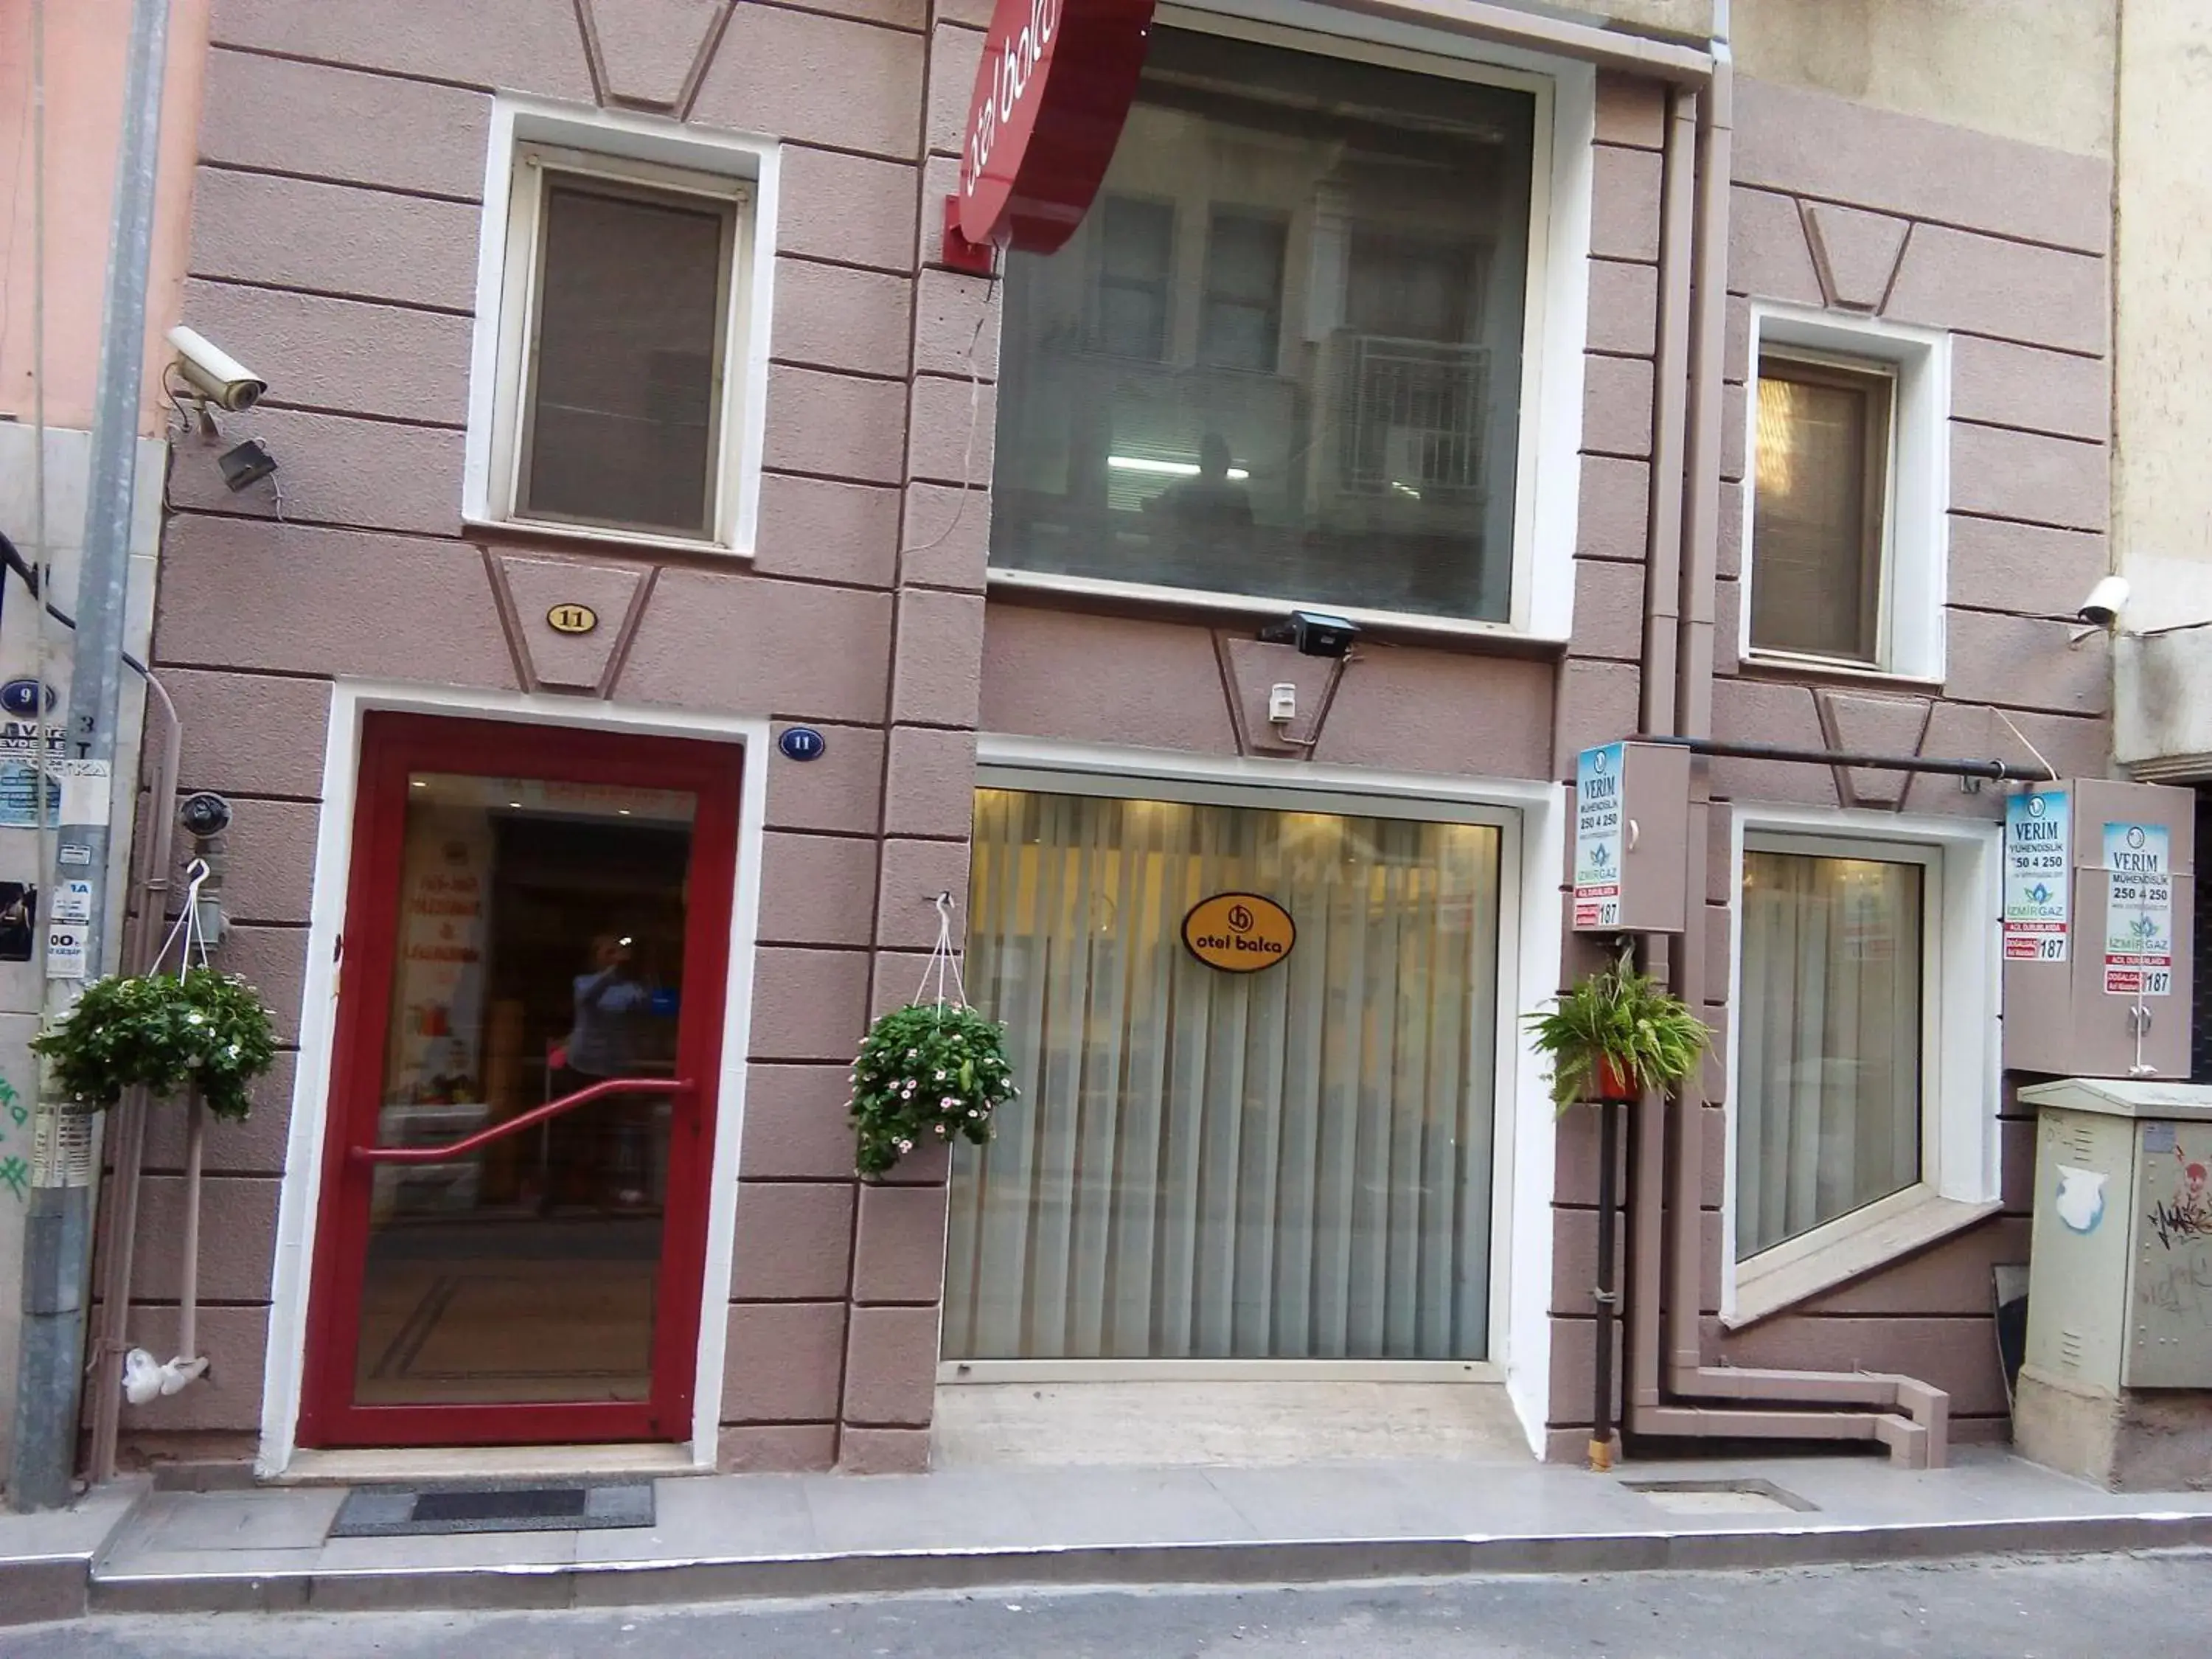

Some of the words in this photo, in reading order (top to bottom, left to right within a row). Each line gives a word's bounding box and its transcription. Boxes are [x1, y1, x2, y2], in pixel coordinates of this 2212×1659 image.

[559, 610, 584, 627] 11
[20, 688, 32, 703] 9
[79, 715, 95, 733] 3
[76, 741, 92, 759] T
[795, 736, 810, 750] 11
[1584, 772, 1615, 799] VERİM
[1580, 816, 1594, 830] 250
[1596, 815, 1601, 827] 4
[1602, 813, 1617, 826] 250
[2014, 816, 2059, 841] VERİM
[2011, 857, 2029, 868] 50
[2032, 857, 2039, 868] 4
[2042, 856, 2062, 868] 250
[2113, 849, 2157, 872] VERİM
[2114, 887, 2136, 899] 250
[2149, 888, 2168, 900] 250
[1599, 903, 1617, 924] 187
[1235, 934, 1282, 953] balca
[2040, 939, 2064, 958] 187
[2147, 973, 2168, 992] 187
